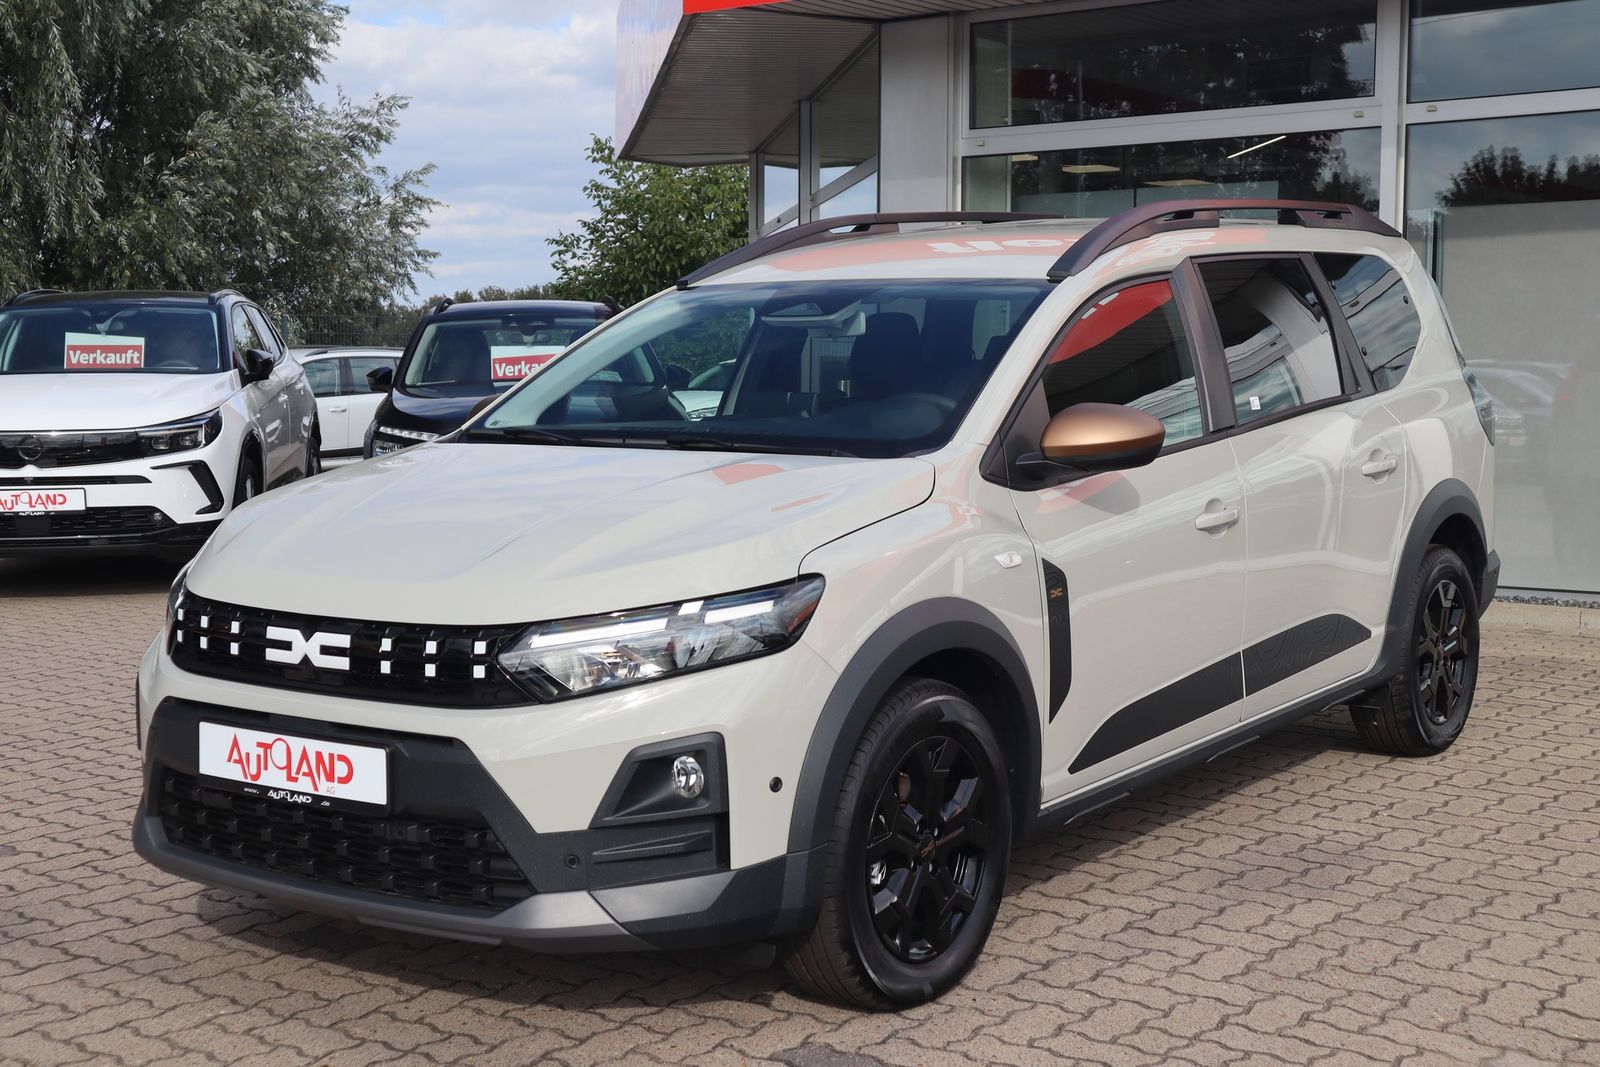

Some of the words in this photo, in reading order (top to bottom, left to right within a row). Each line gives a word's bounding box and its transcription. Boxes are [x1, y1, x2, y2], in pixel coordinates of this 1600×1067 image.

[69, 349, 140, 365] Verkauft
[494, 360, 545, 377] Verka
[227, 732, 353, 792] AUTOLAND
[267, 790, 312, 804] AUTOLAND
[325, 787, 336, 796] AG
